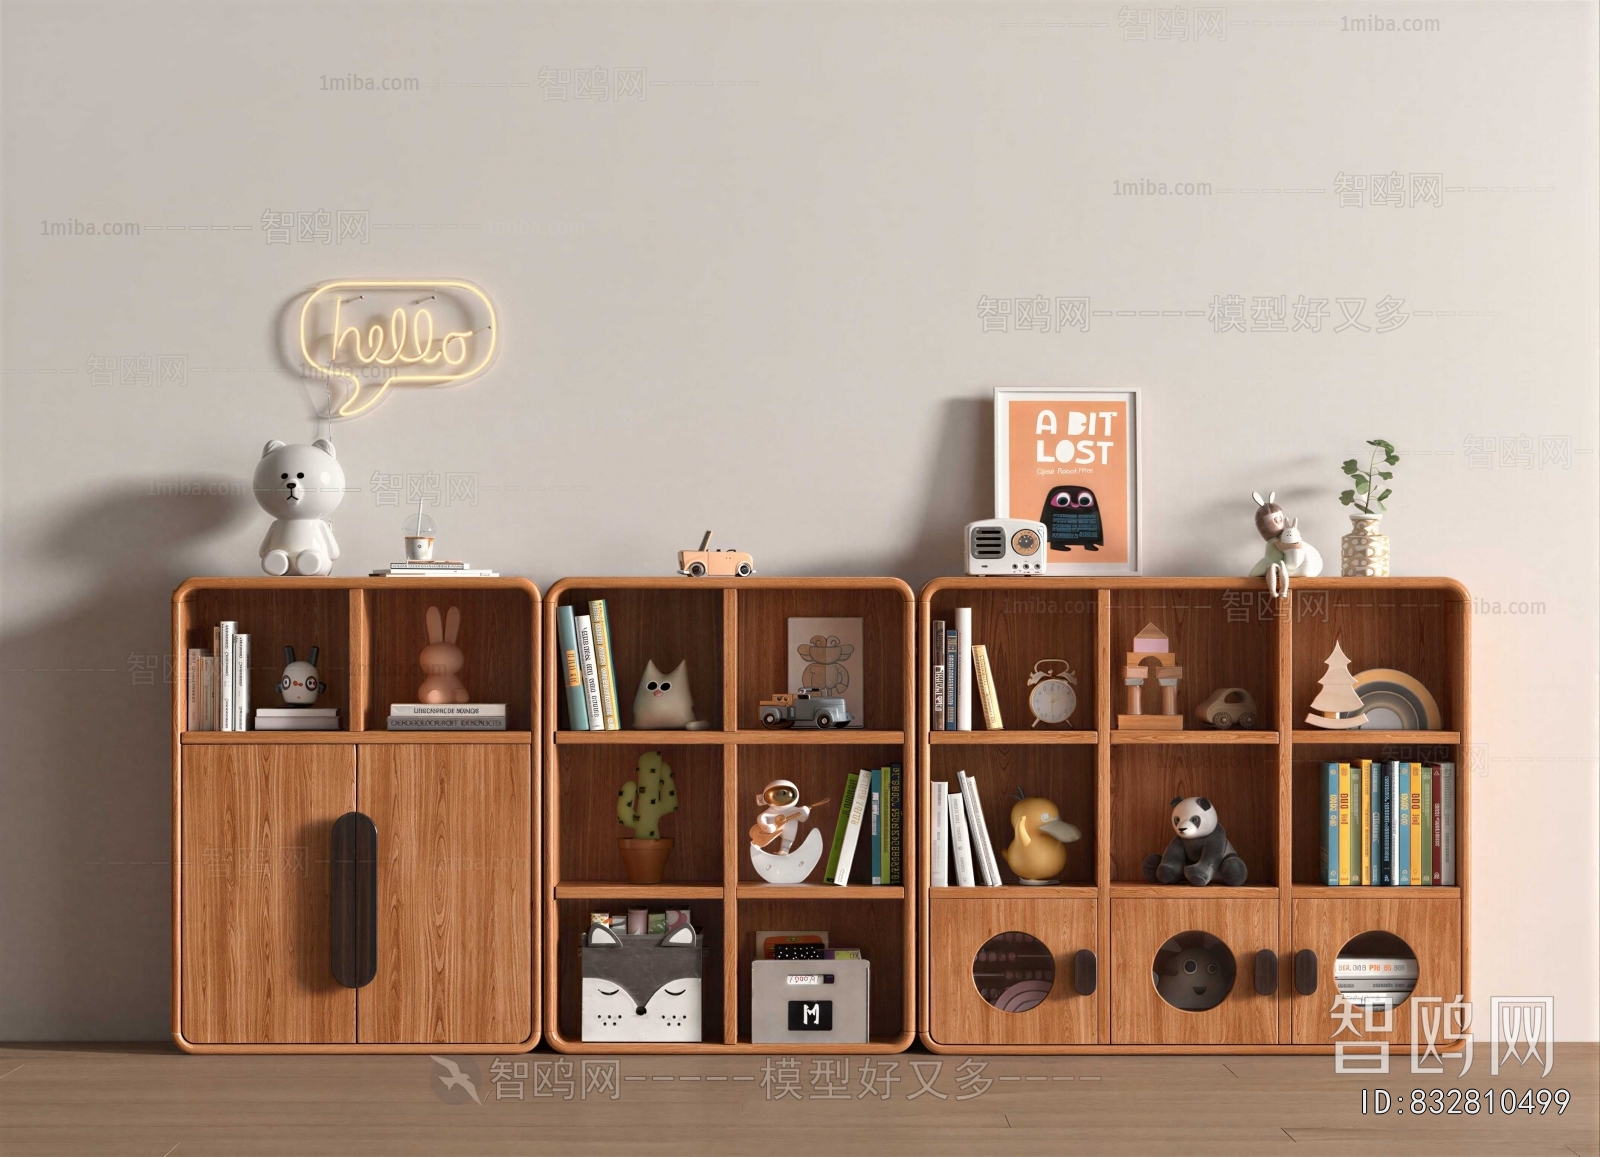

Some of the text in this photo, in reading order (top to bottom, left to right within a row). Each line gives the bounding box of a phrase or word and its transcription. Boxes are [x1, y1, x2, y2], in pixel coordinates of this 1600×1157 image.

[332, 297, 473, 365] hello
[1035, 409, 1058, 435] A
[1036, 439, 1115, 465] LOST
[803, 1003, 820, 1025] M
